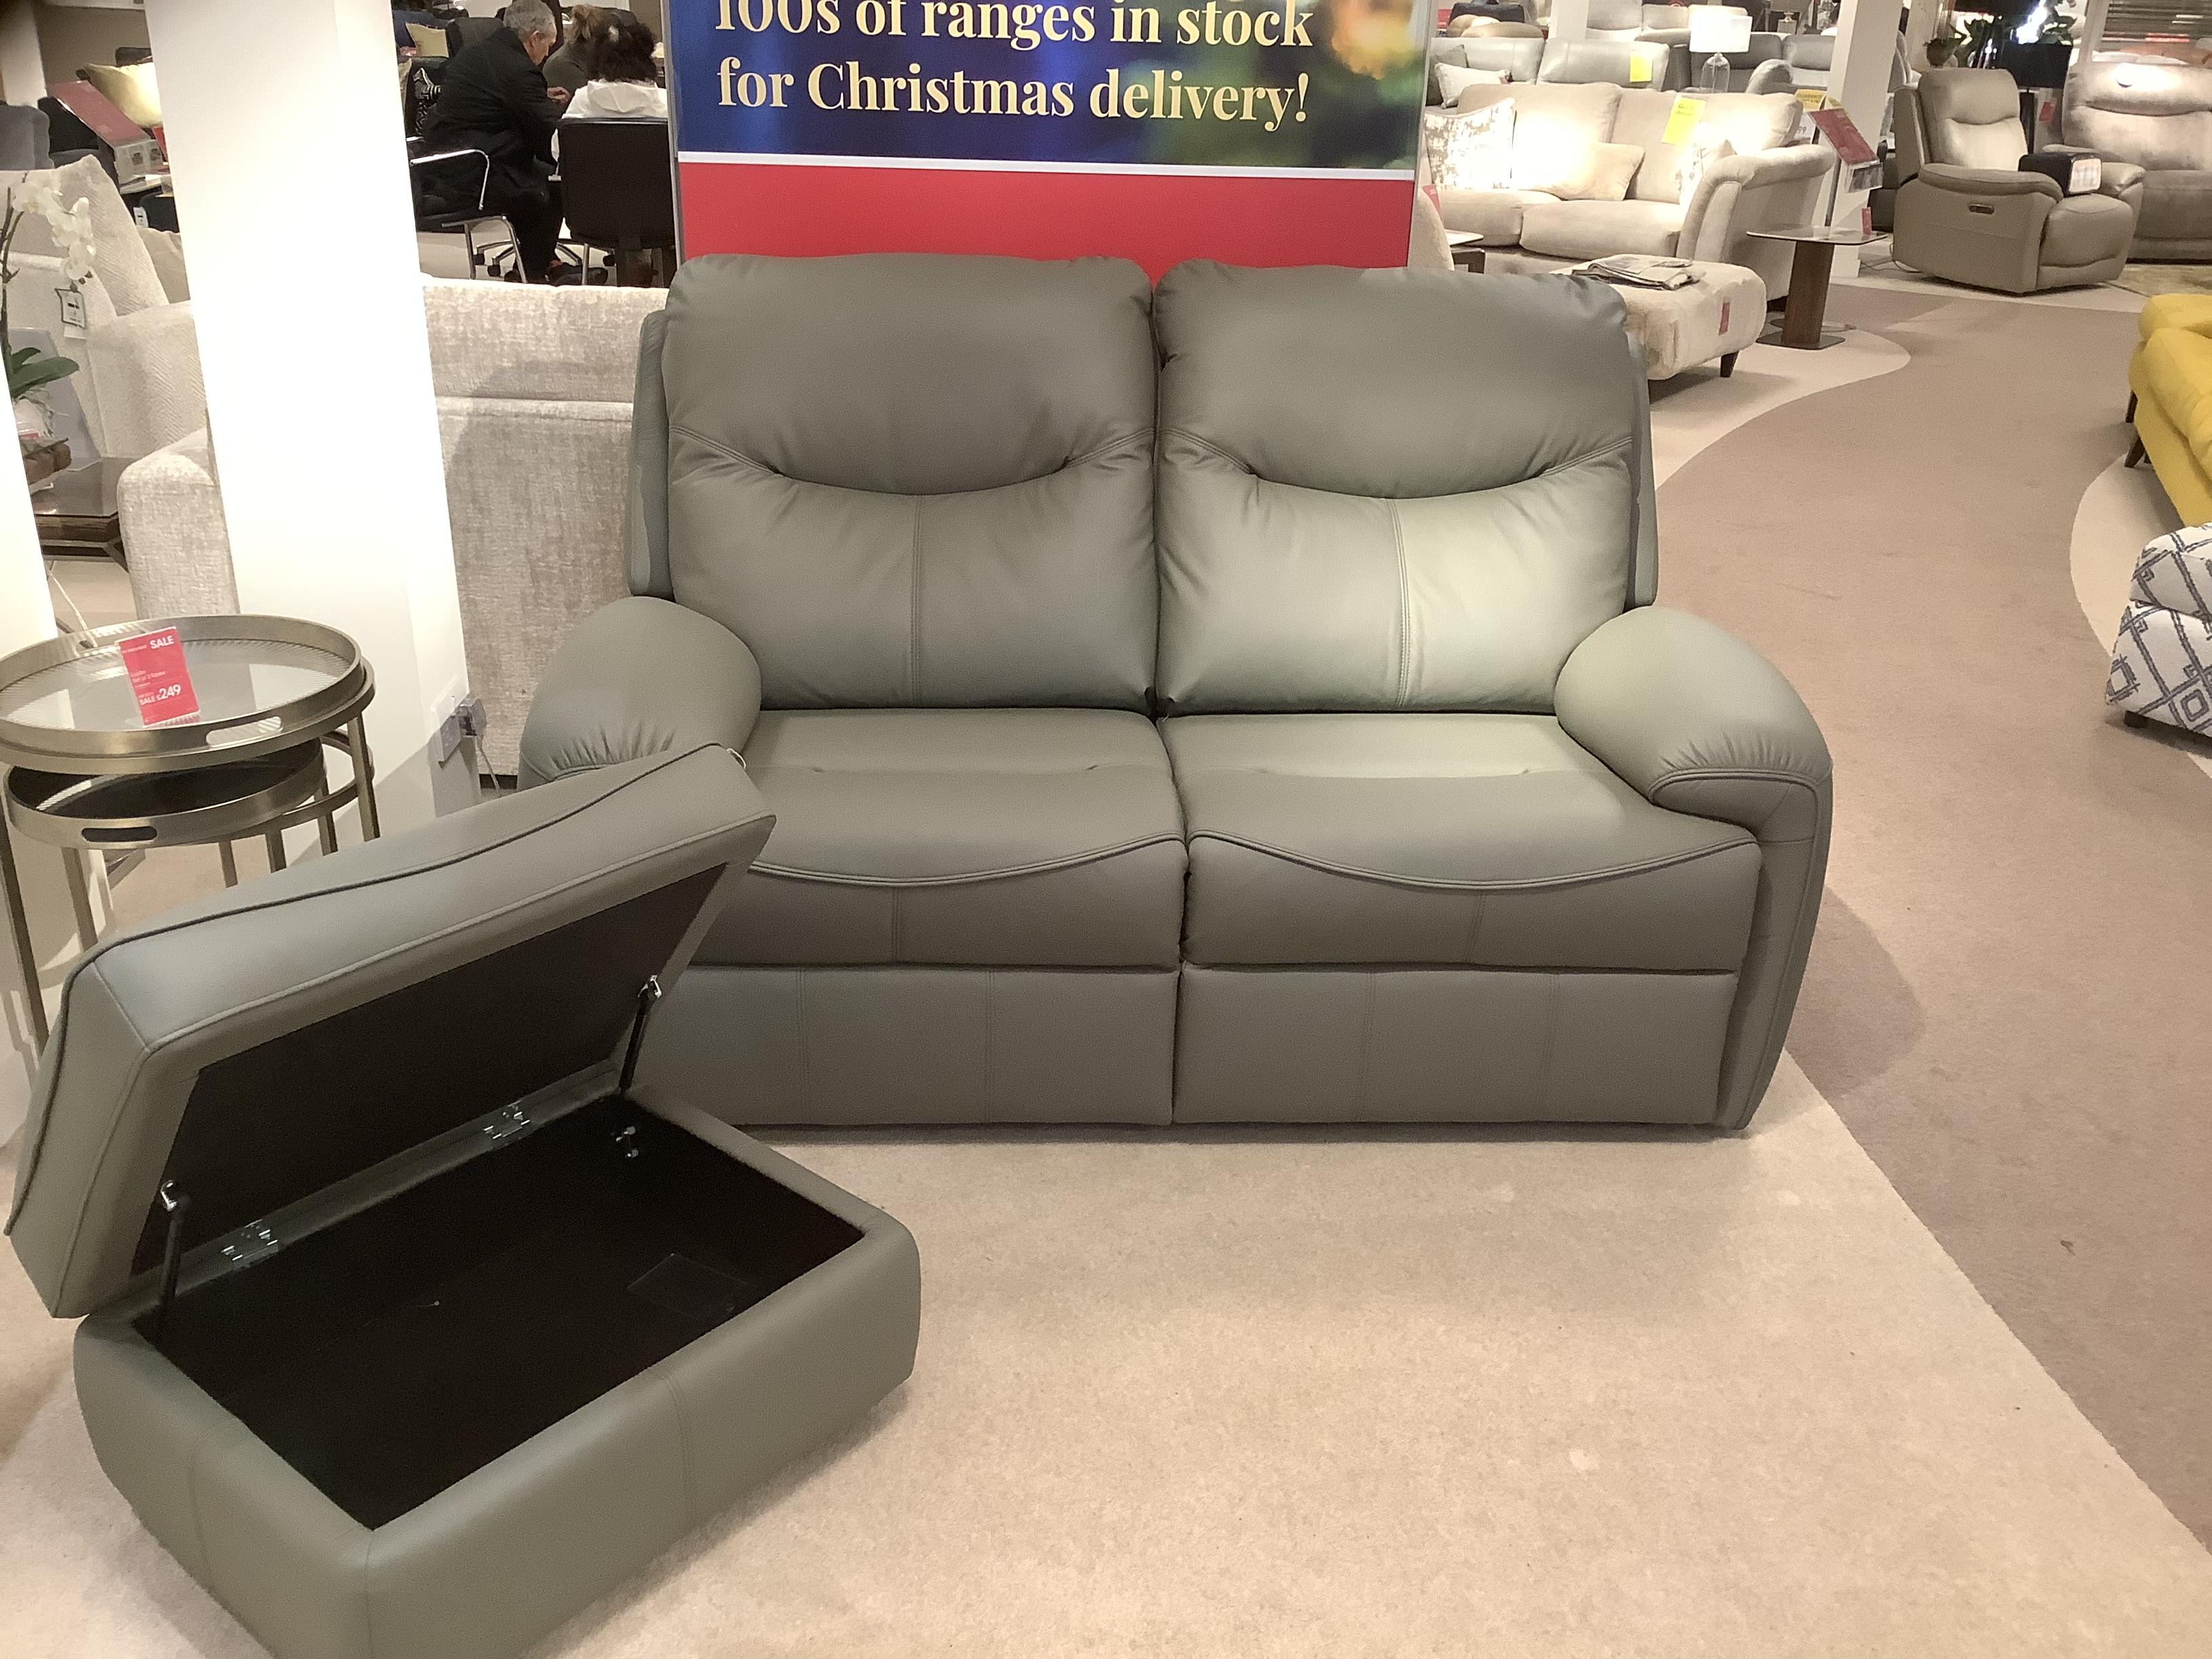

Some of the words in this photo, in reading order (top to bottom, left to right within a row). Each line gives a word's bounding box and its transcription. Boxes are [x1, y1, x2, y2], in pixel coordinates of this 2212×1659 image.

[716, 0, 840, 34] 100s
[856, 0, 907, 36] of
[921, 1, 1096, 52] ranges
[1109, 0, 1162, 43] in
[1176, 0, 1314, 47] stock
[717, 56, 795, 108] for
[807, 60, 1075, 117] Christmas
[1089, 68, 1309, 132] delivery!
[150, 635, 175, 650] SALE
[139, 695, 157, 705] SALE
